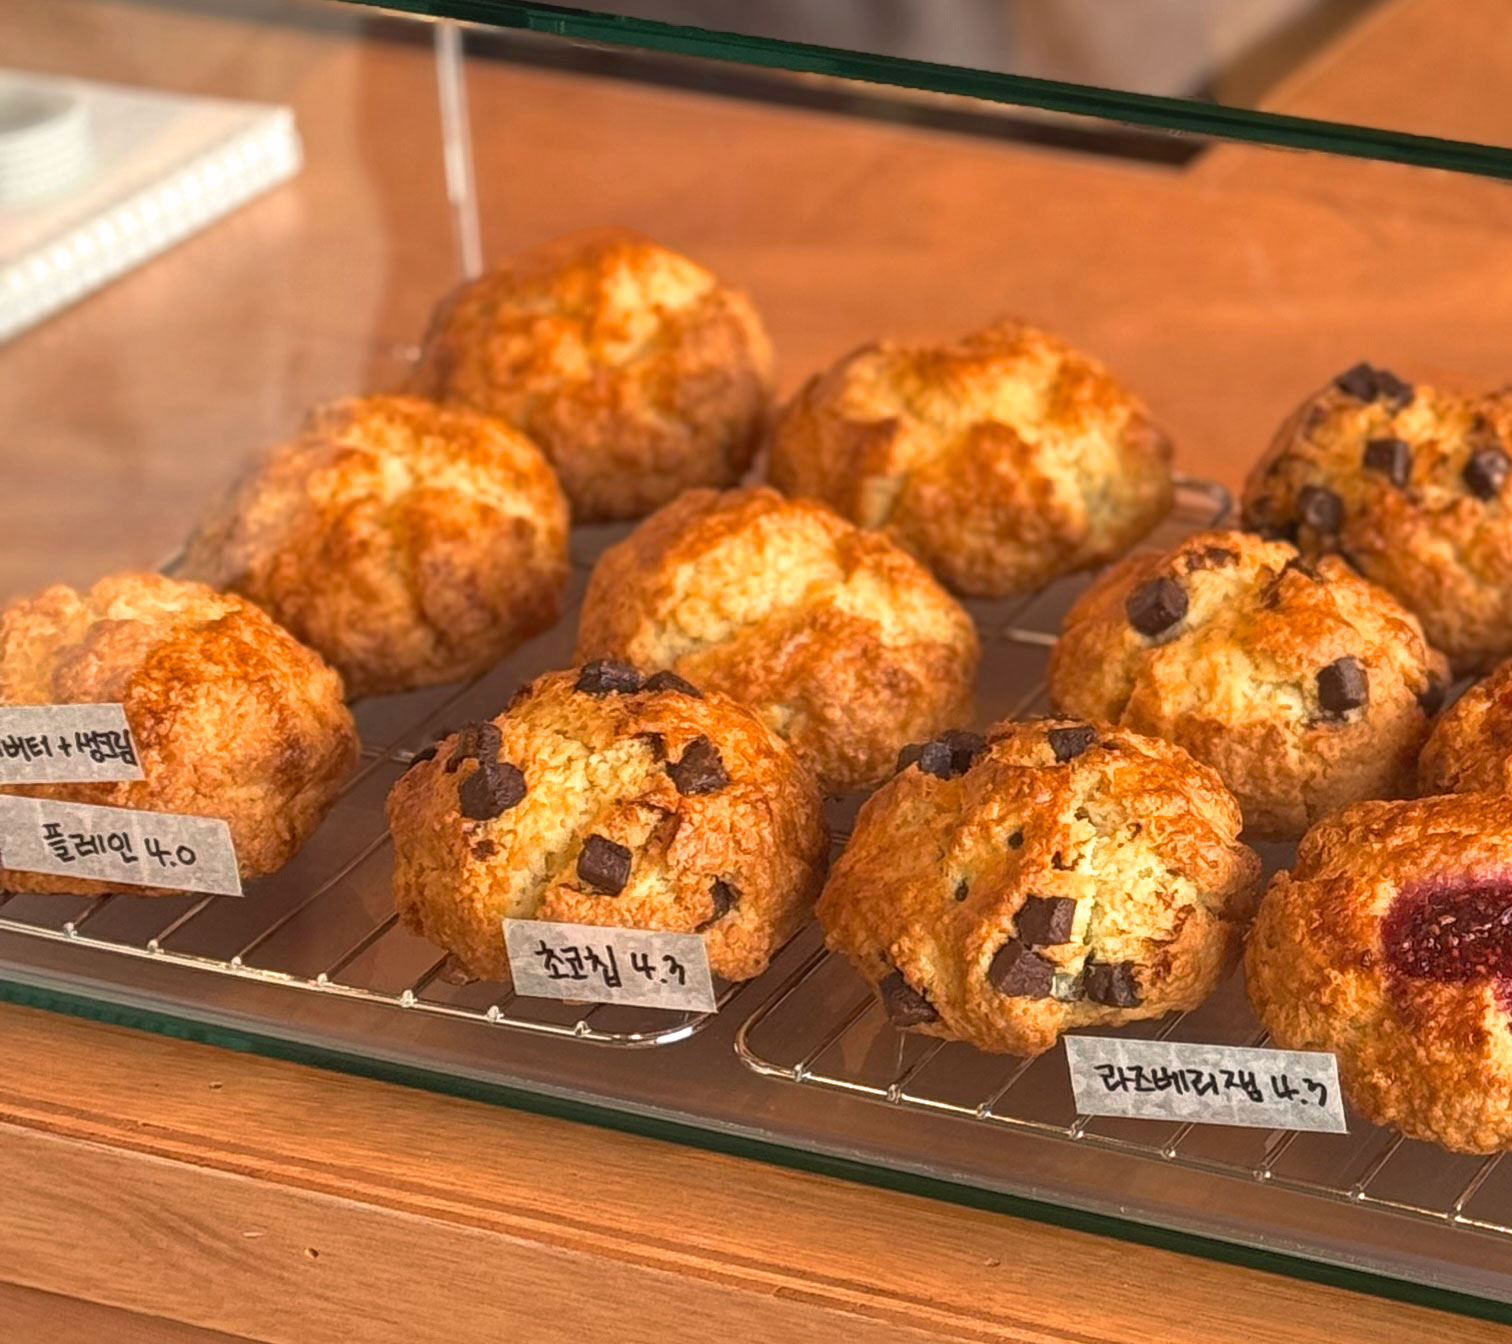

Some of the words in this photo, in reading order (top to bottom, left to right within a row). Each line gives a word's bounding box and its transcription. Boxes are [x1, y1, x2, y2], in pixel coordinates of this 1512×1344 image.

[0, 733, 54, 762] 버터
[42, 822, 139, 865] 플레인
[144, 837, 197, 868] 4.0
[534, 939, 623, 989] 초코칩
[630, 951, 687, 986] 4.3
[1094, 1063, 1264, 1103] 라즈베리잼
[1270, 1073, 1329, 1108] 4.3
